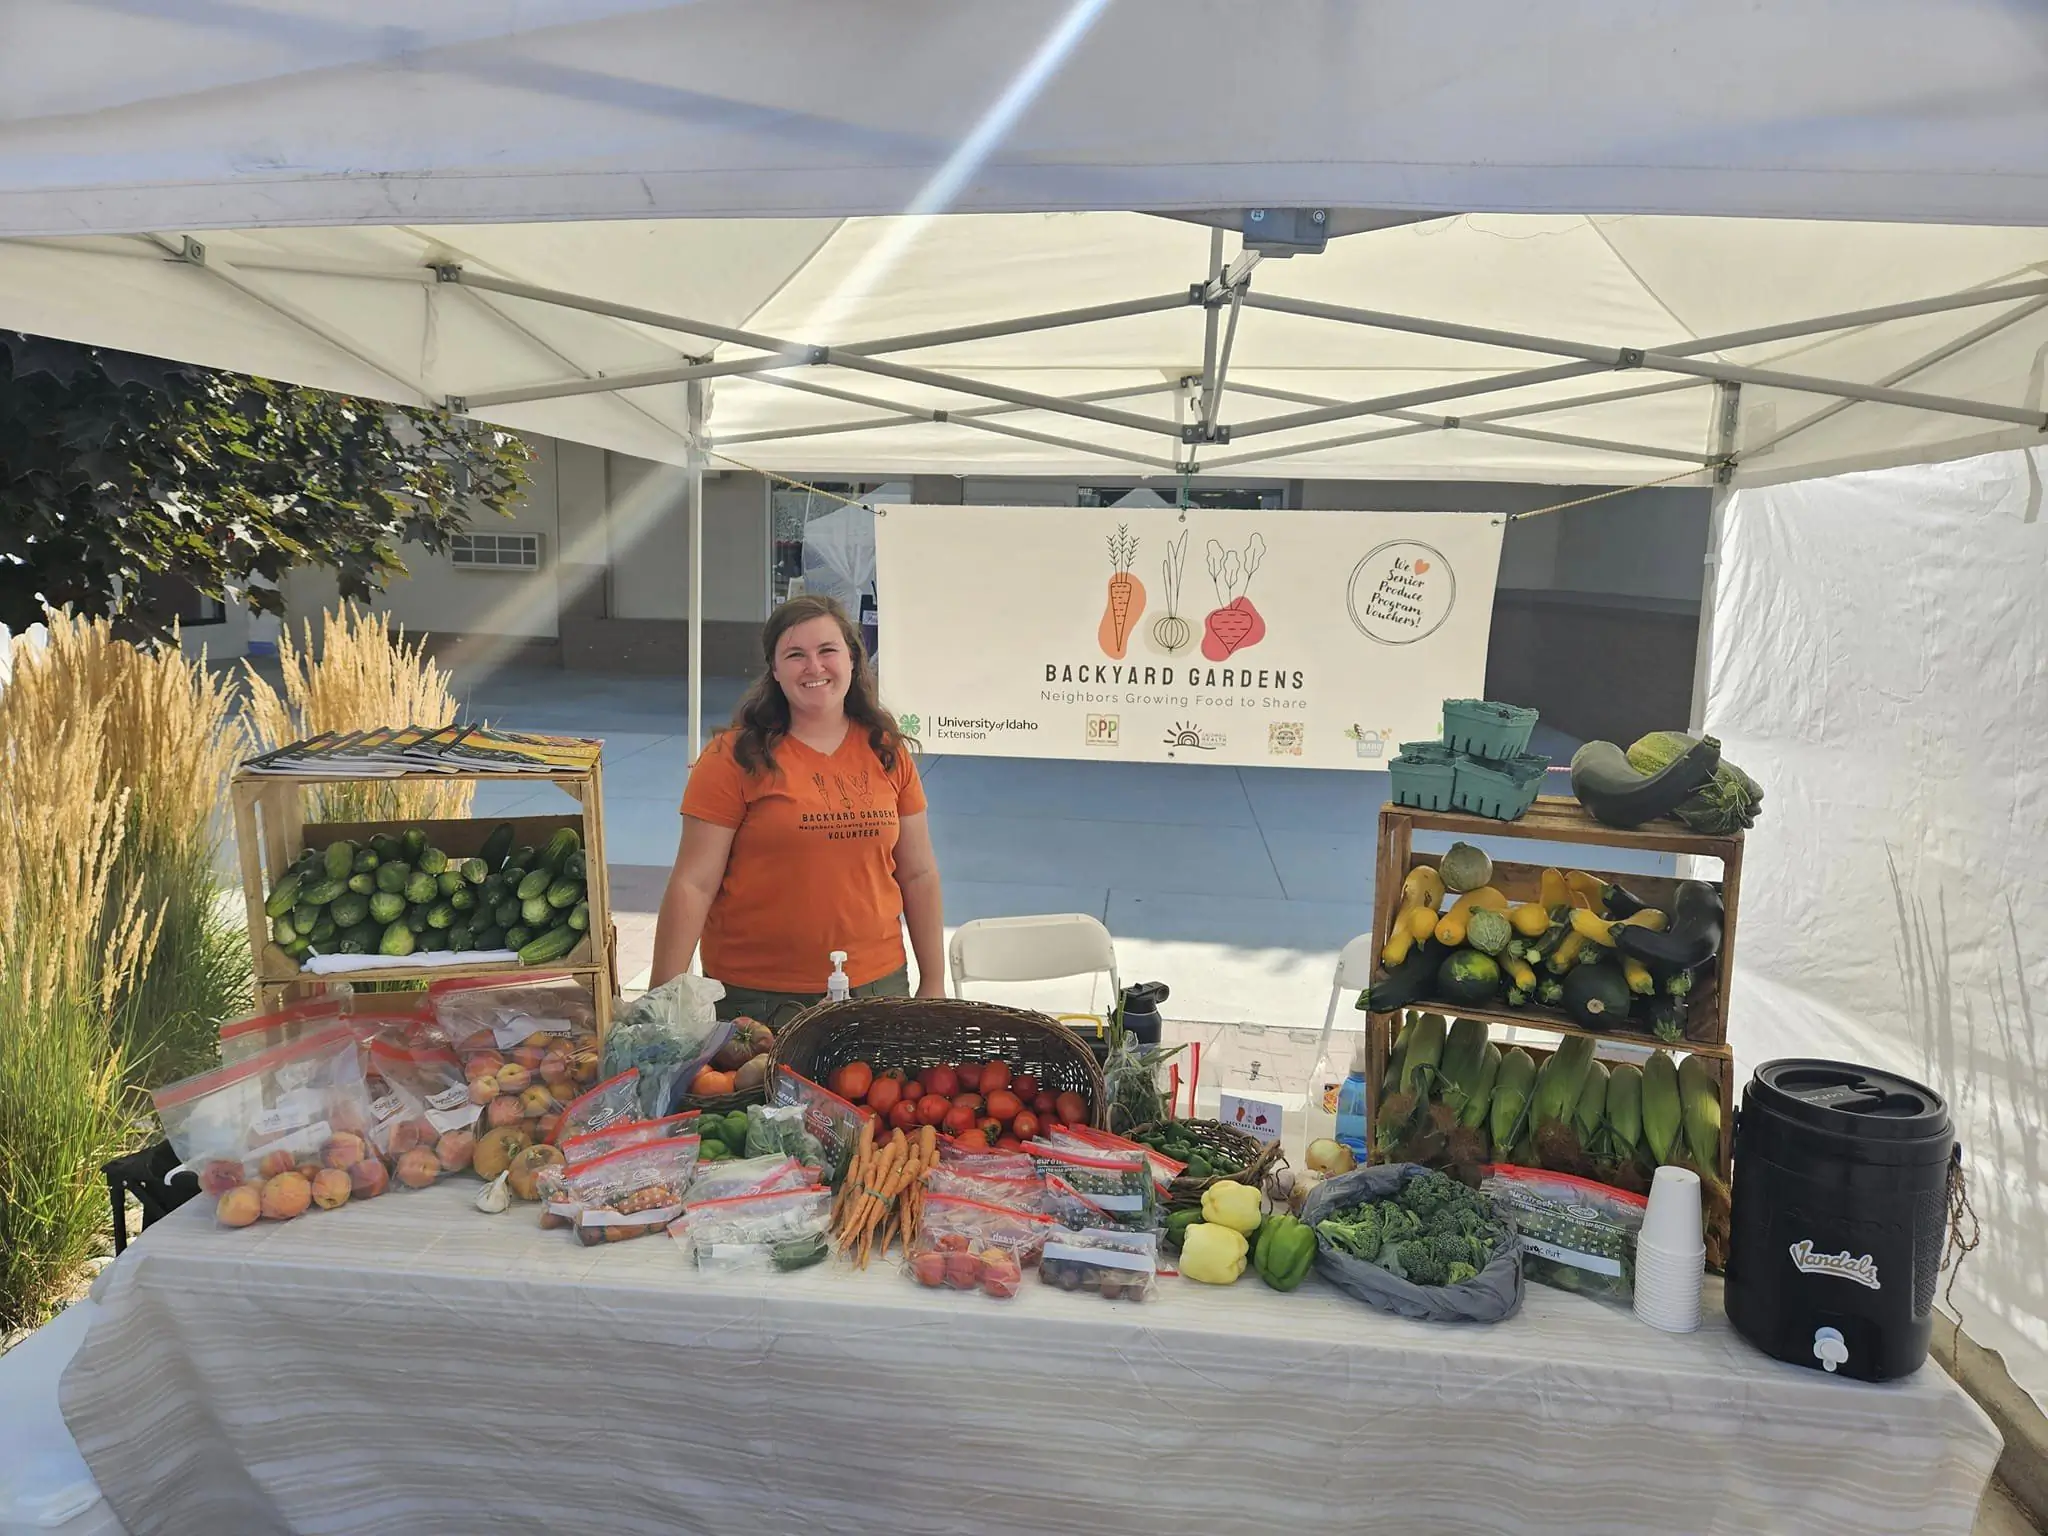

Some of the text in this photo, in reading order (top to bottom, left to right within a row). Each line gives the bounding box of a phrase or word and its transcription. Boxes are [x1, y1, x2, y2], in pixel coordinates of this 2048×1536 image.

[1394, 557, 1411, 571] We
[1387, 569, 1425, 588] Senior
[1379, 580, 1424, 602] Produce
[1371, 592, 1422, 615] Program
[1366, 604, 1422, 628] Vouchers!
[1045, 664, 1304, 689] BACKYARD GARDENS
[1040, 690, 1307, 709] Neighbors Growing Food to Share
[937, 716, 1038, 731] University of Idaho
[1088, 718, 1118, 739] SPP
[937, 729, 987, 740] Extension
[802, 812, 856, 822] BACKYARD
[828, 828, 880, 840] VOLUNTEER
[1790, 1240, 1879, 1287] Vandals
